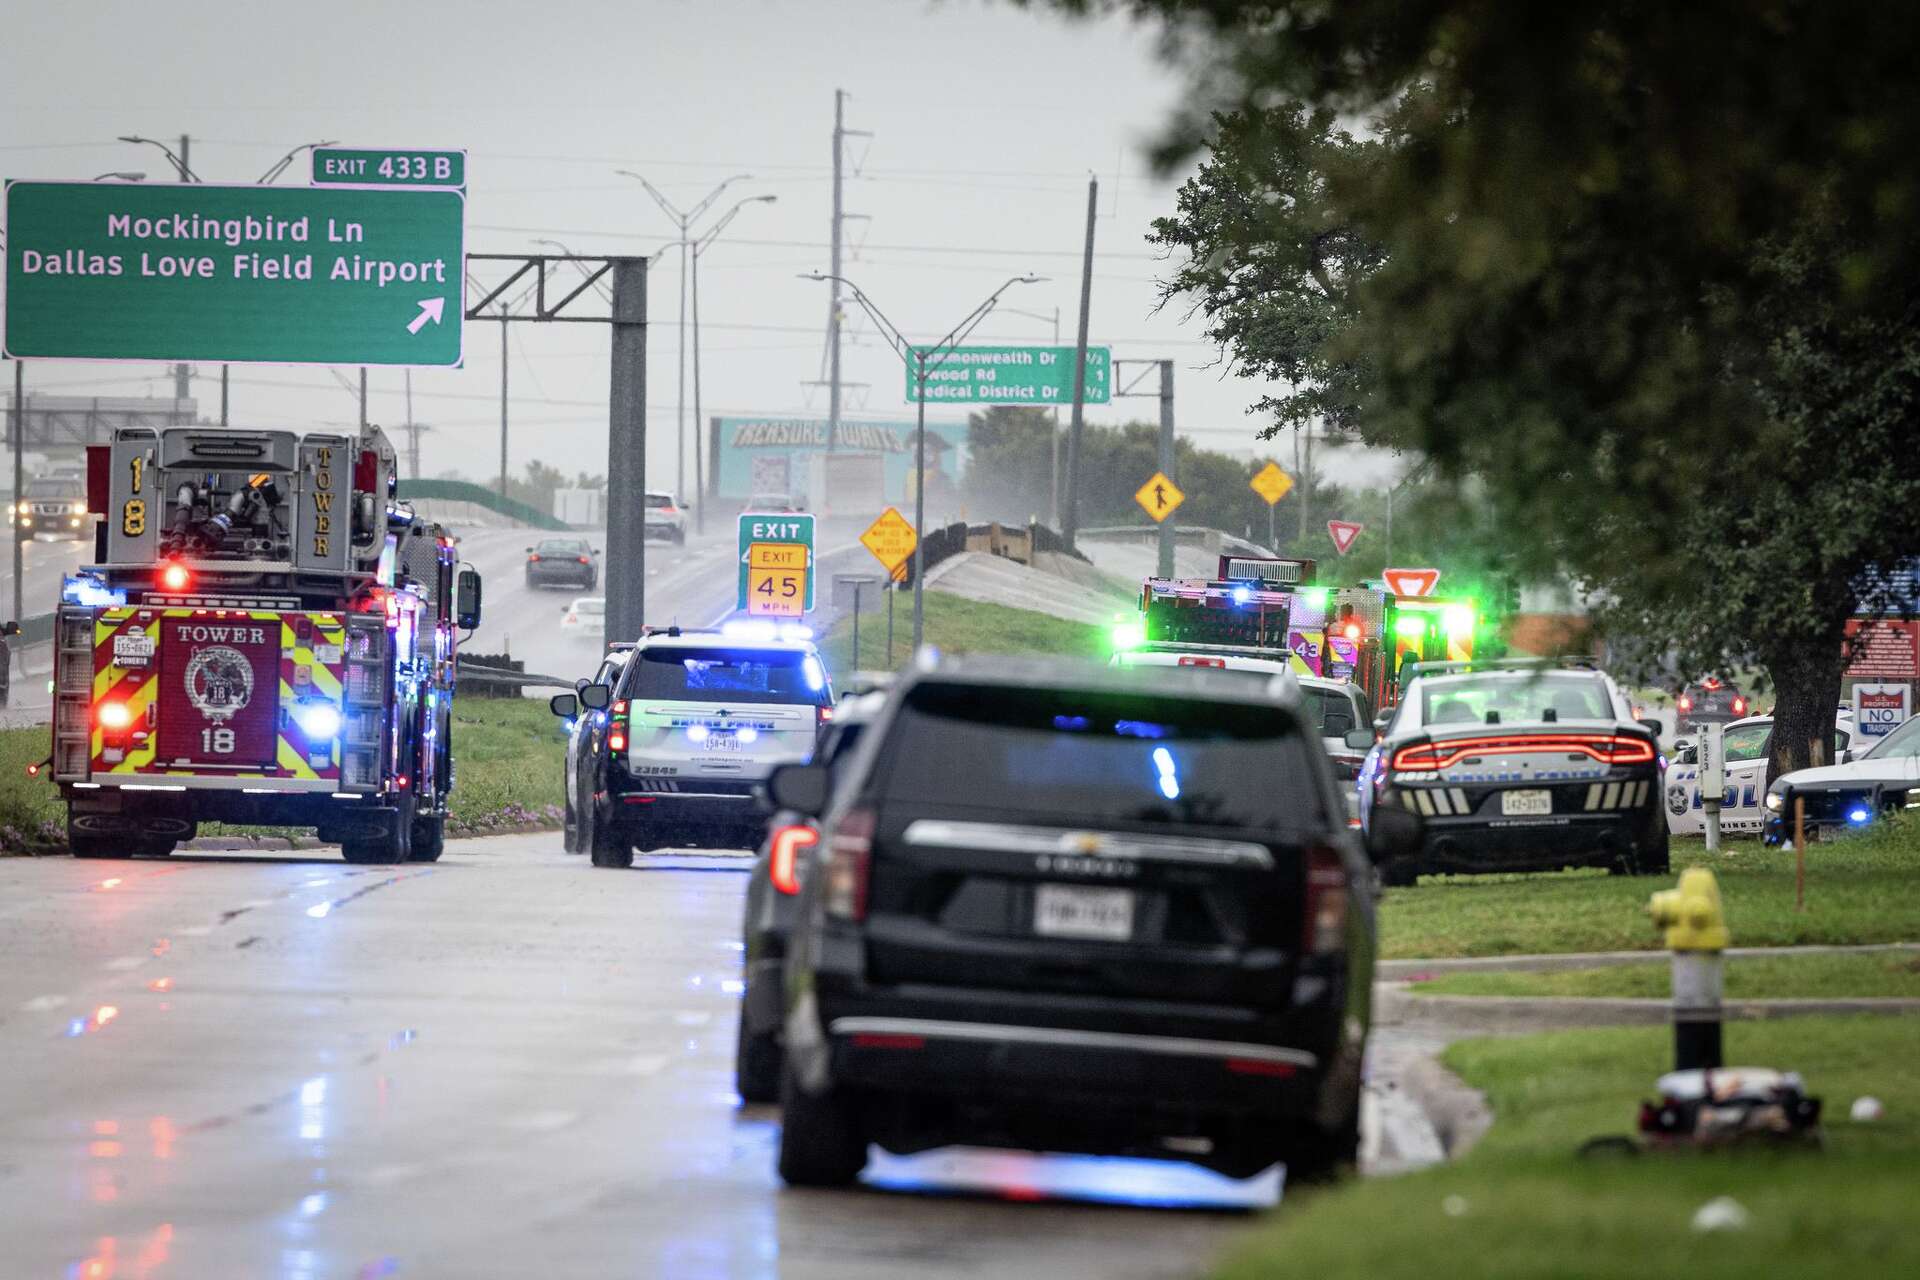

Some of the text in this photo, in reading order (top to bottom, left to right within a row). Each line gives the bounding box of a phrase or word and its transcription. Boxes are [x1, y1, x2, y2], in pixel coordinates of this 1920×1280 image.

[325, 156, 452, 179] EXIT 433 B
[107, 213, 364, 246] Mockingbird Ln
[22, 249, 447, 288] Dallas Love Field Airport
[1040, 351, 1057, 365] Dr
[975, 368, 997, 382] Rd
[979, 384, 1035, 399] District
[1042, 385, 1060, 400] Dr
[731, 419, 827, 449] TREASURE
[312, 447, 335, 558] TOWER
[752, 523, 801, 539] EXIT
[762, 552, 793, 563] EXIT
[757, 577, 798, 598] 45
[762, 603, 790, 611] MPH
[177, 626, 266, 644] TOWER
[1295, 641, 1319, 658] 43
[1869, 709, 1895, 722] NO
[201, 727, 236, 754] 18
